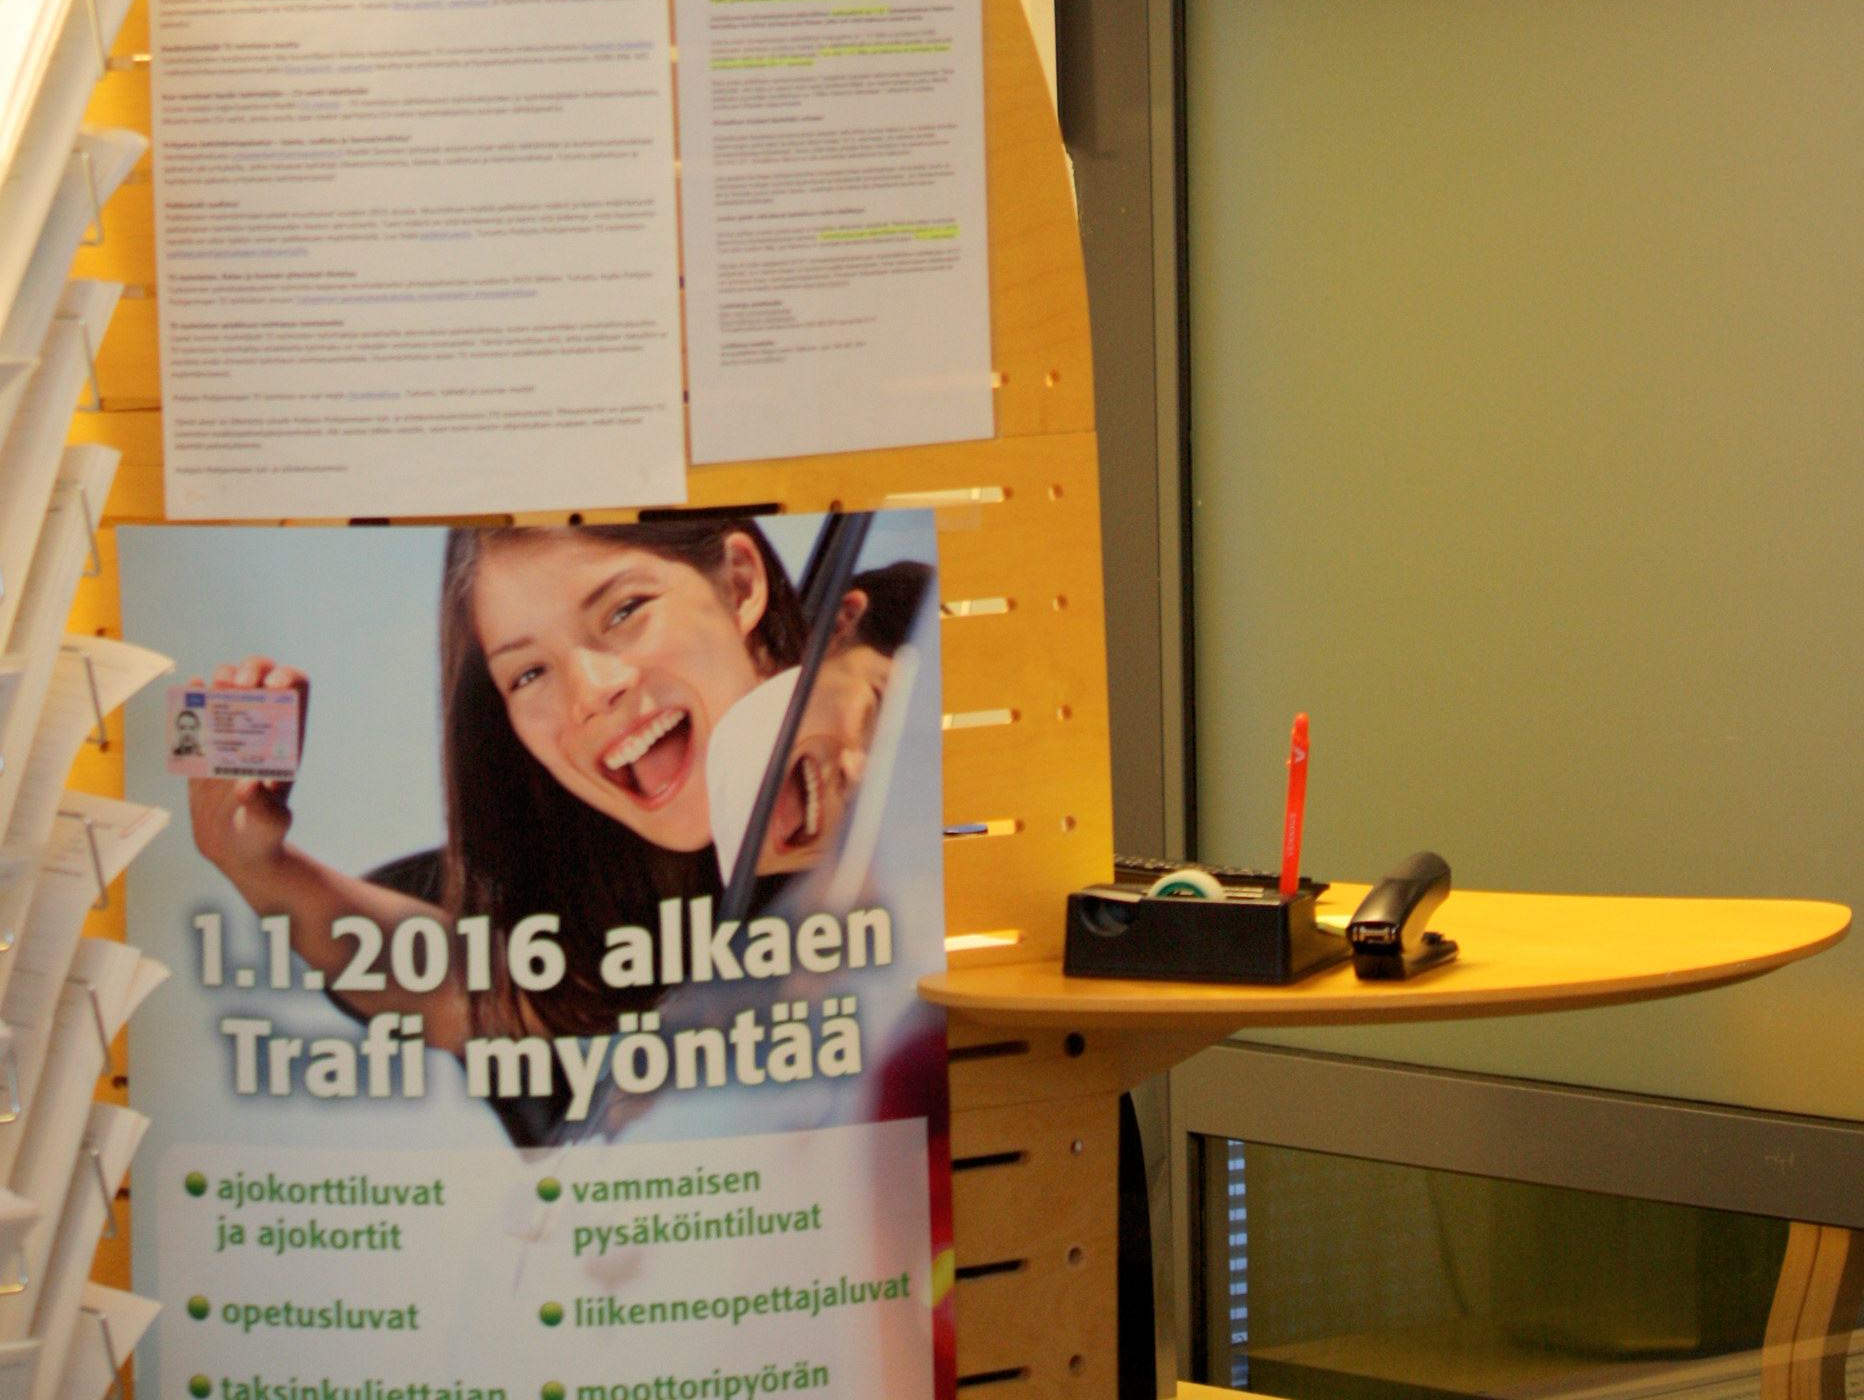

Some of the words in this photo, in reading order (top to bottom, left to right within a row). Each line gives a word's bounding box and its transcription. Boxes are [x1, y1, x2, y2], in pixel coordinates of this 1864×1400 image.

[194, 911, 567, 993] 1.1.2016
[601, 897, 894, 989] alkaen
[219, 1013, 426, 1100] Trafi
[465, 995, 865, 1122] myöntää
[216, 1173, 446, 1208] ajokorttiluvat
[570, 1167, 763, 1204] vammaisen
[215, 1216, 246, 1254] ja
[256, 1219, 403, 1257] ajokortit
[572, 1203, 824, 1257] pysäköintiluvat
[219, 1300, 420, 1338] opetusluvat
[573, 1271, 912, 1330] liikenneopettajaluvat
[574, 1360, 830, 1400] moottoripyörän
